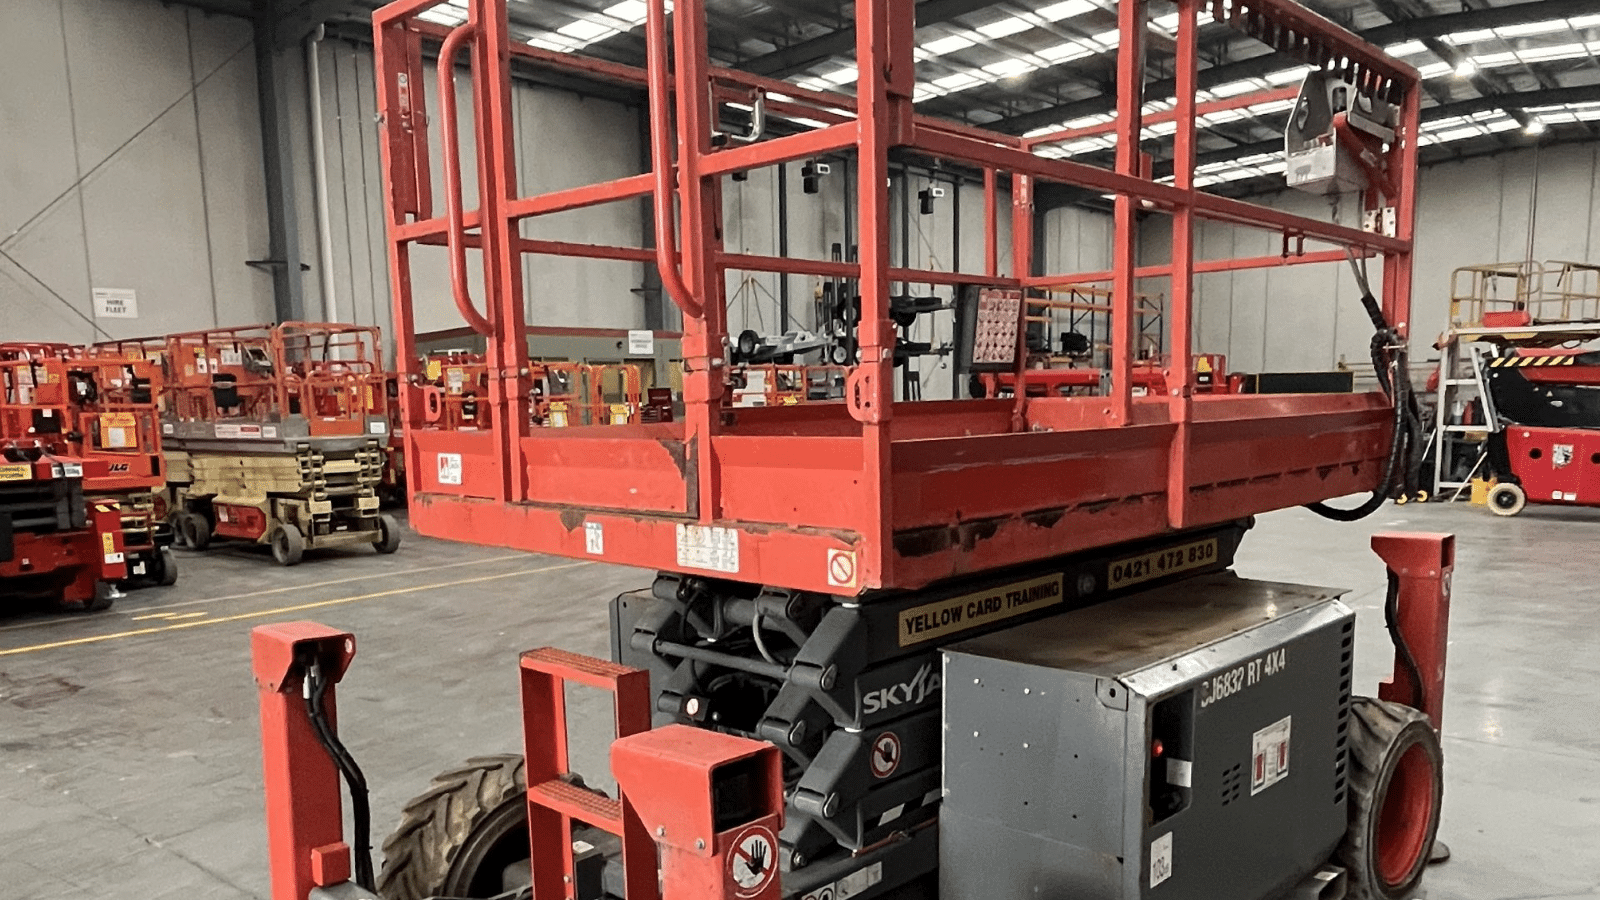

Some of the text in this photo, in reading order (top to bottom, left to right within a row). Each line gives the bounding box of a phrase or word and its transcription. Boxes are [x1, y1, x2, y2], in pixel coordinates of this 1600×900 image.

[109, 463, 129, 472] JLG
[1113, 542, 1213, 582] 0421 472 830
[905, 580, 1060, 635] YELLOW CARD TRAINING
[1247, 658, 1262, 687] RT
[1264, 647, 1286, 677] 4X4
[863, 662, 942, 715] SKYJA
